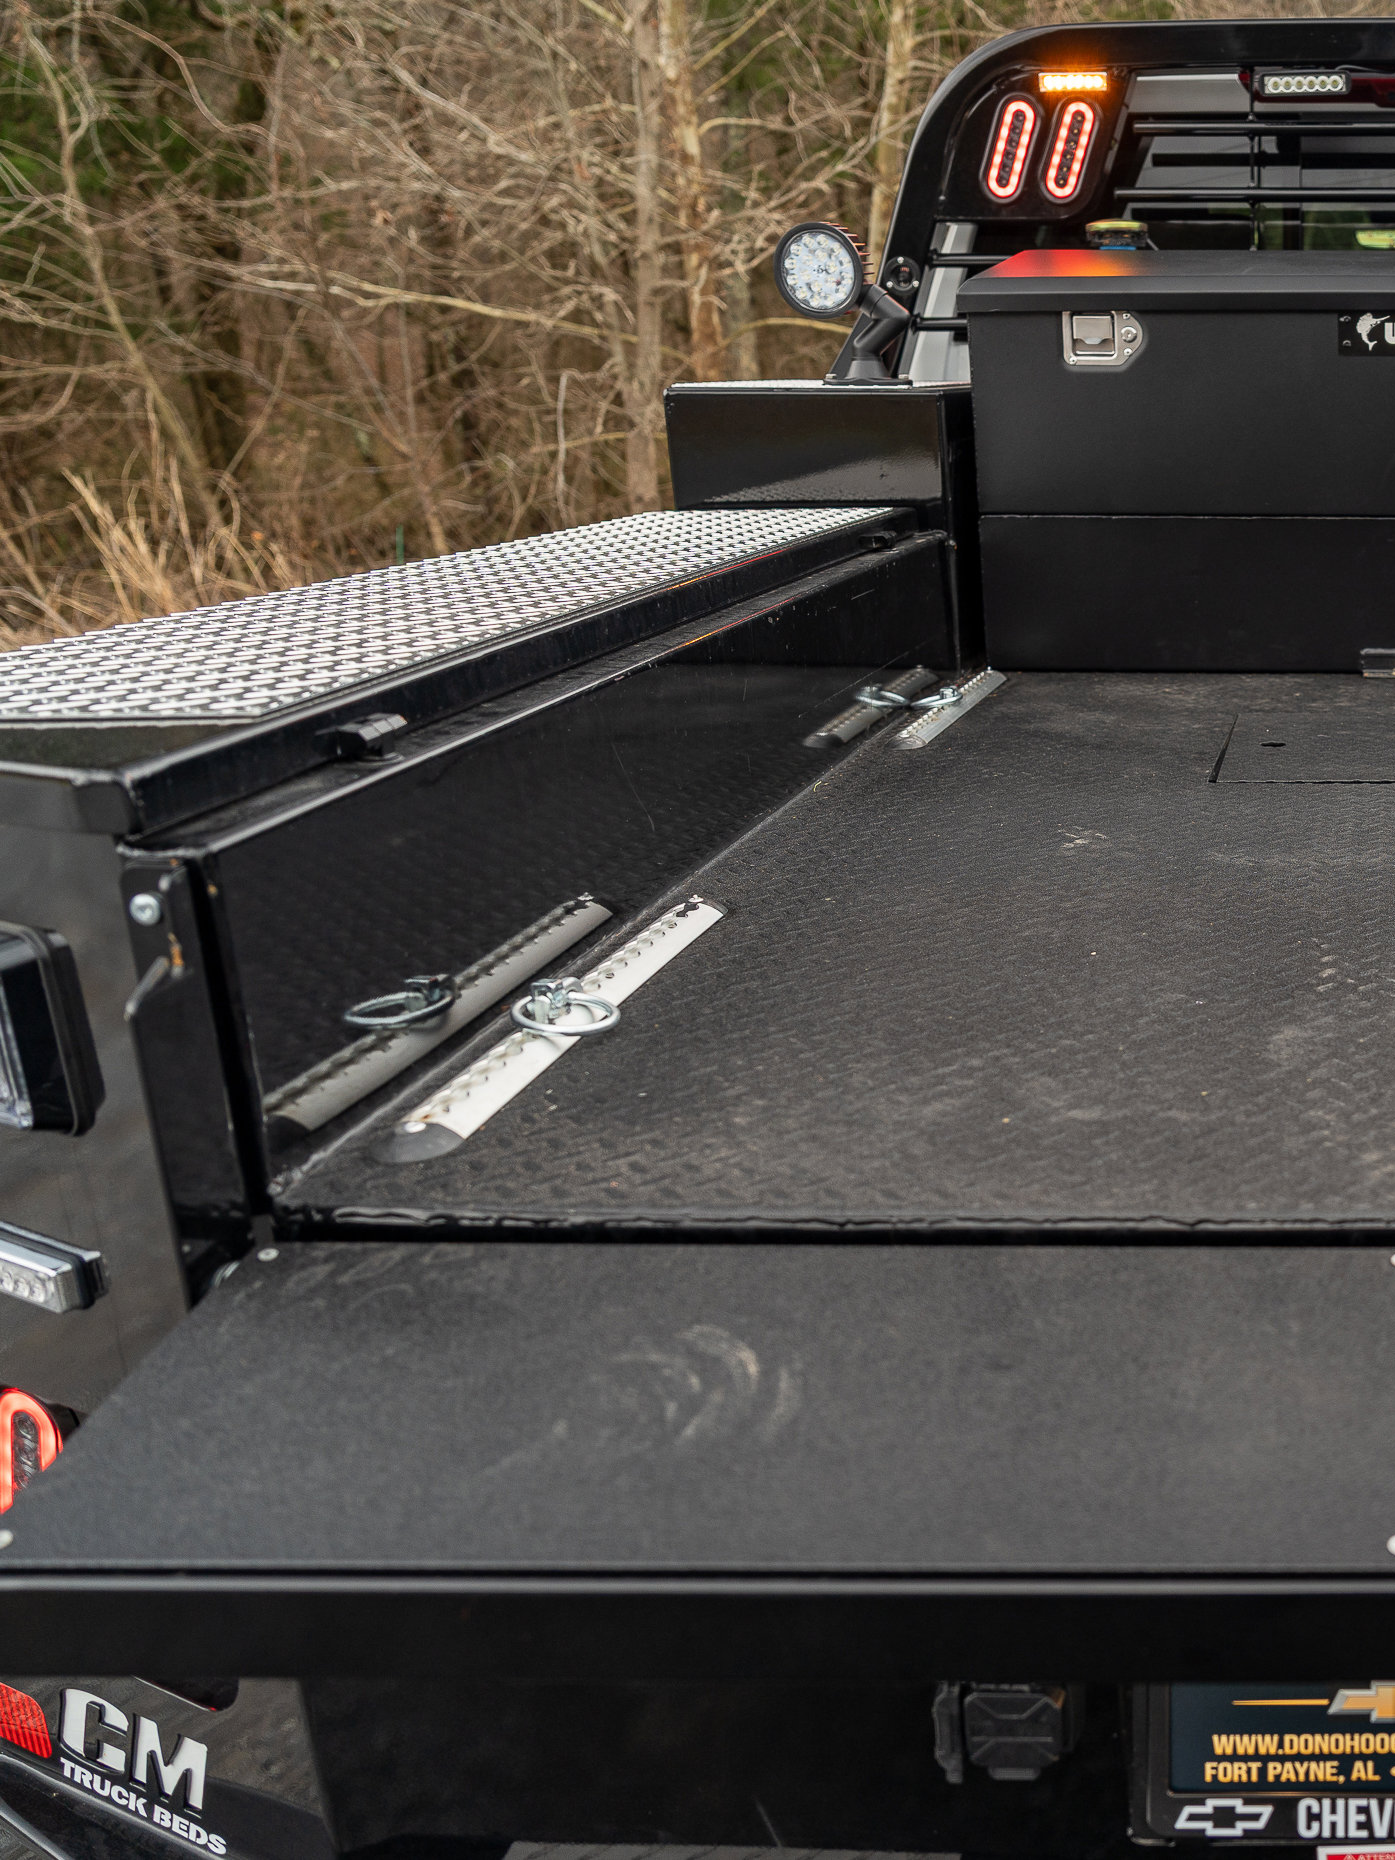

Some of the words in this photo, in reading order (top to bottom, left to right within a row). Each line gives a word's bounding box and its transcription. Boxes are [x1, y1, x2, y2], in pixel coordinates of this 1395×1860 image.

[60, 1688, 208, 1815] CM
[1204, 1761, 1262, 1783] FORT
[1267, 1760, 1346, 1784] PAYNE,
[1350, 1760, 1381, 1782] AL
[60, 1757, 148, 1818] TRUCK
[152, 1804, 227, 1855] BEDS
